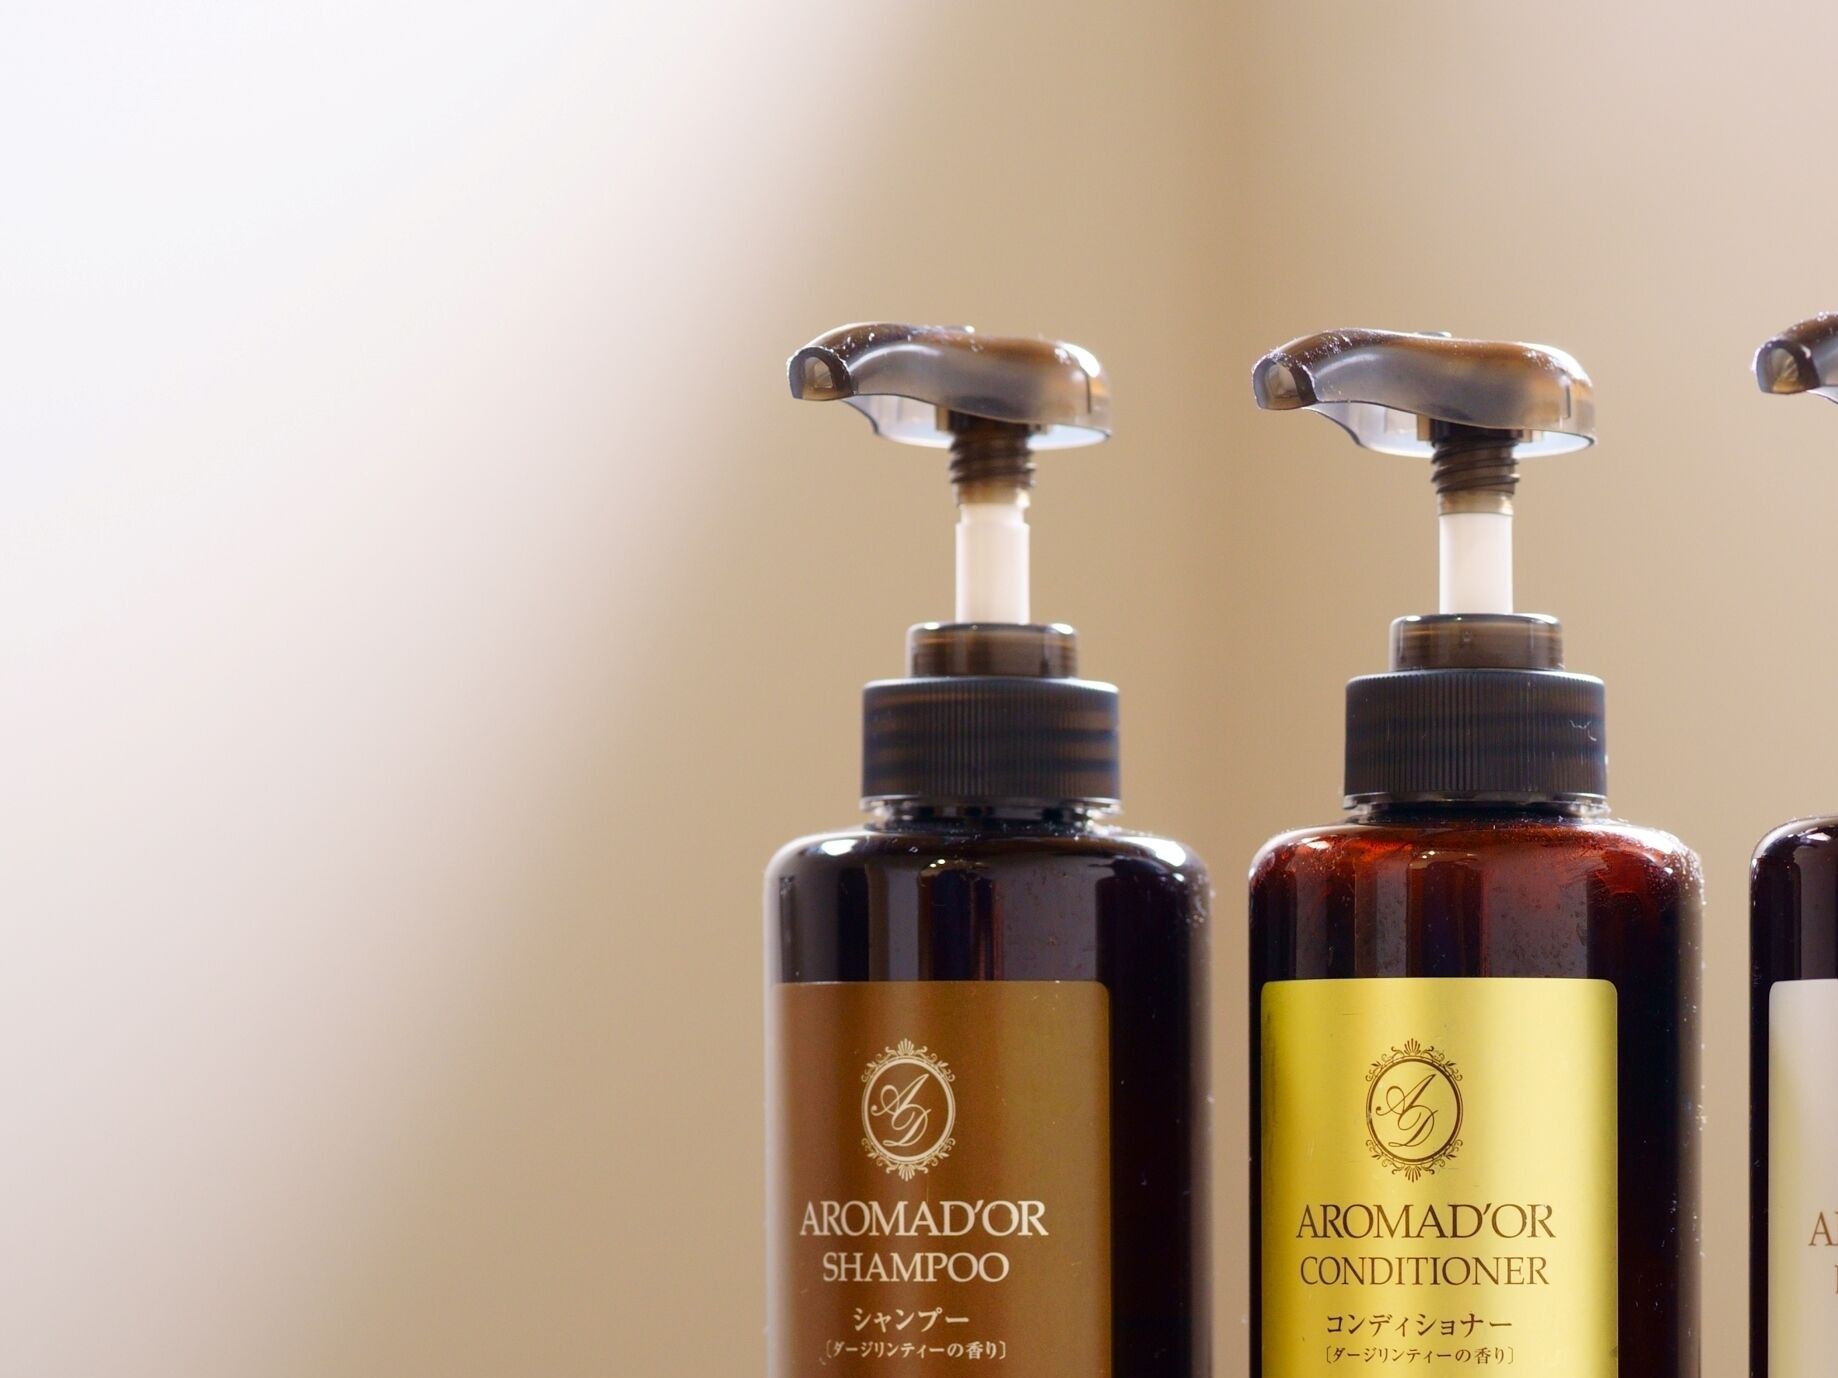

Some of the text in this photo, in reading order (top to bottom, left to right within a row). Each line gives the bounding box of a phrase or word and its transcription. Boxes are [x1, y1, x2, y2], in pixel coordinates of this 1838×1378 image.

[799, 1199, 1049, 1236] AROMAD'OR
[1296, 1203, 1557, 1239] AROMAD'OR
[822, 1252, 1010, 1282] SHAMPOO
[1300, 1256, 1550, 1286] CONDITIONER
[852, 1307, 969, 1333] シャンプー
[1326, 1313, 1513, 1337] コンディショナー
